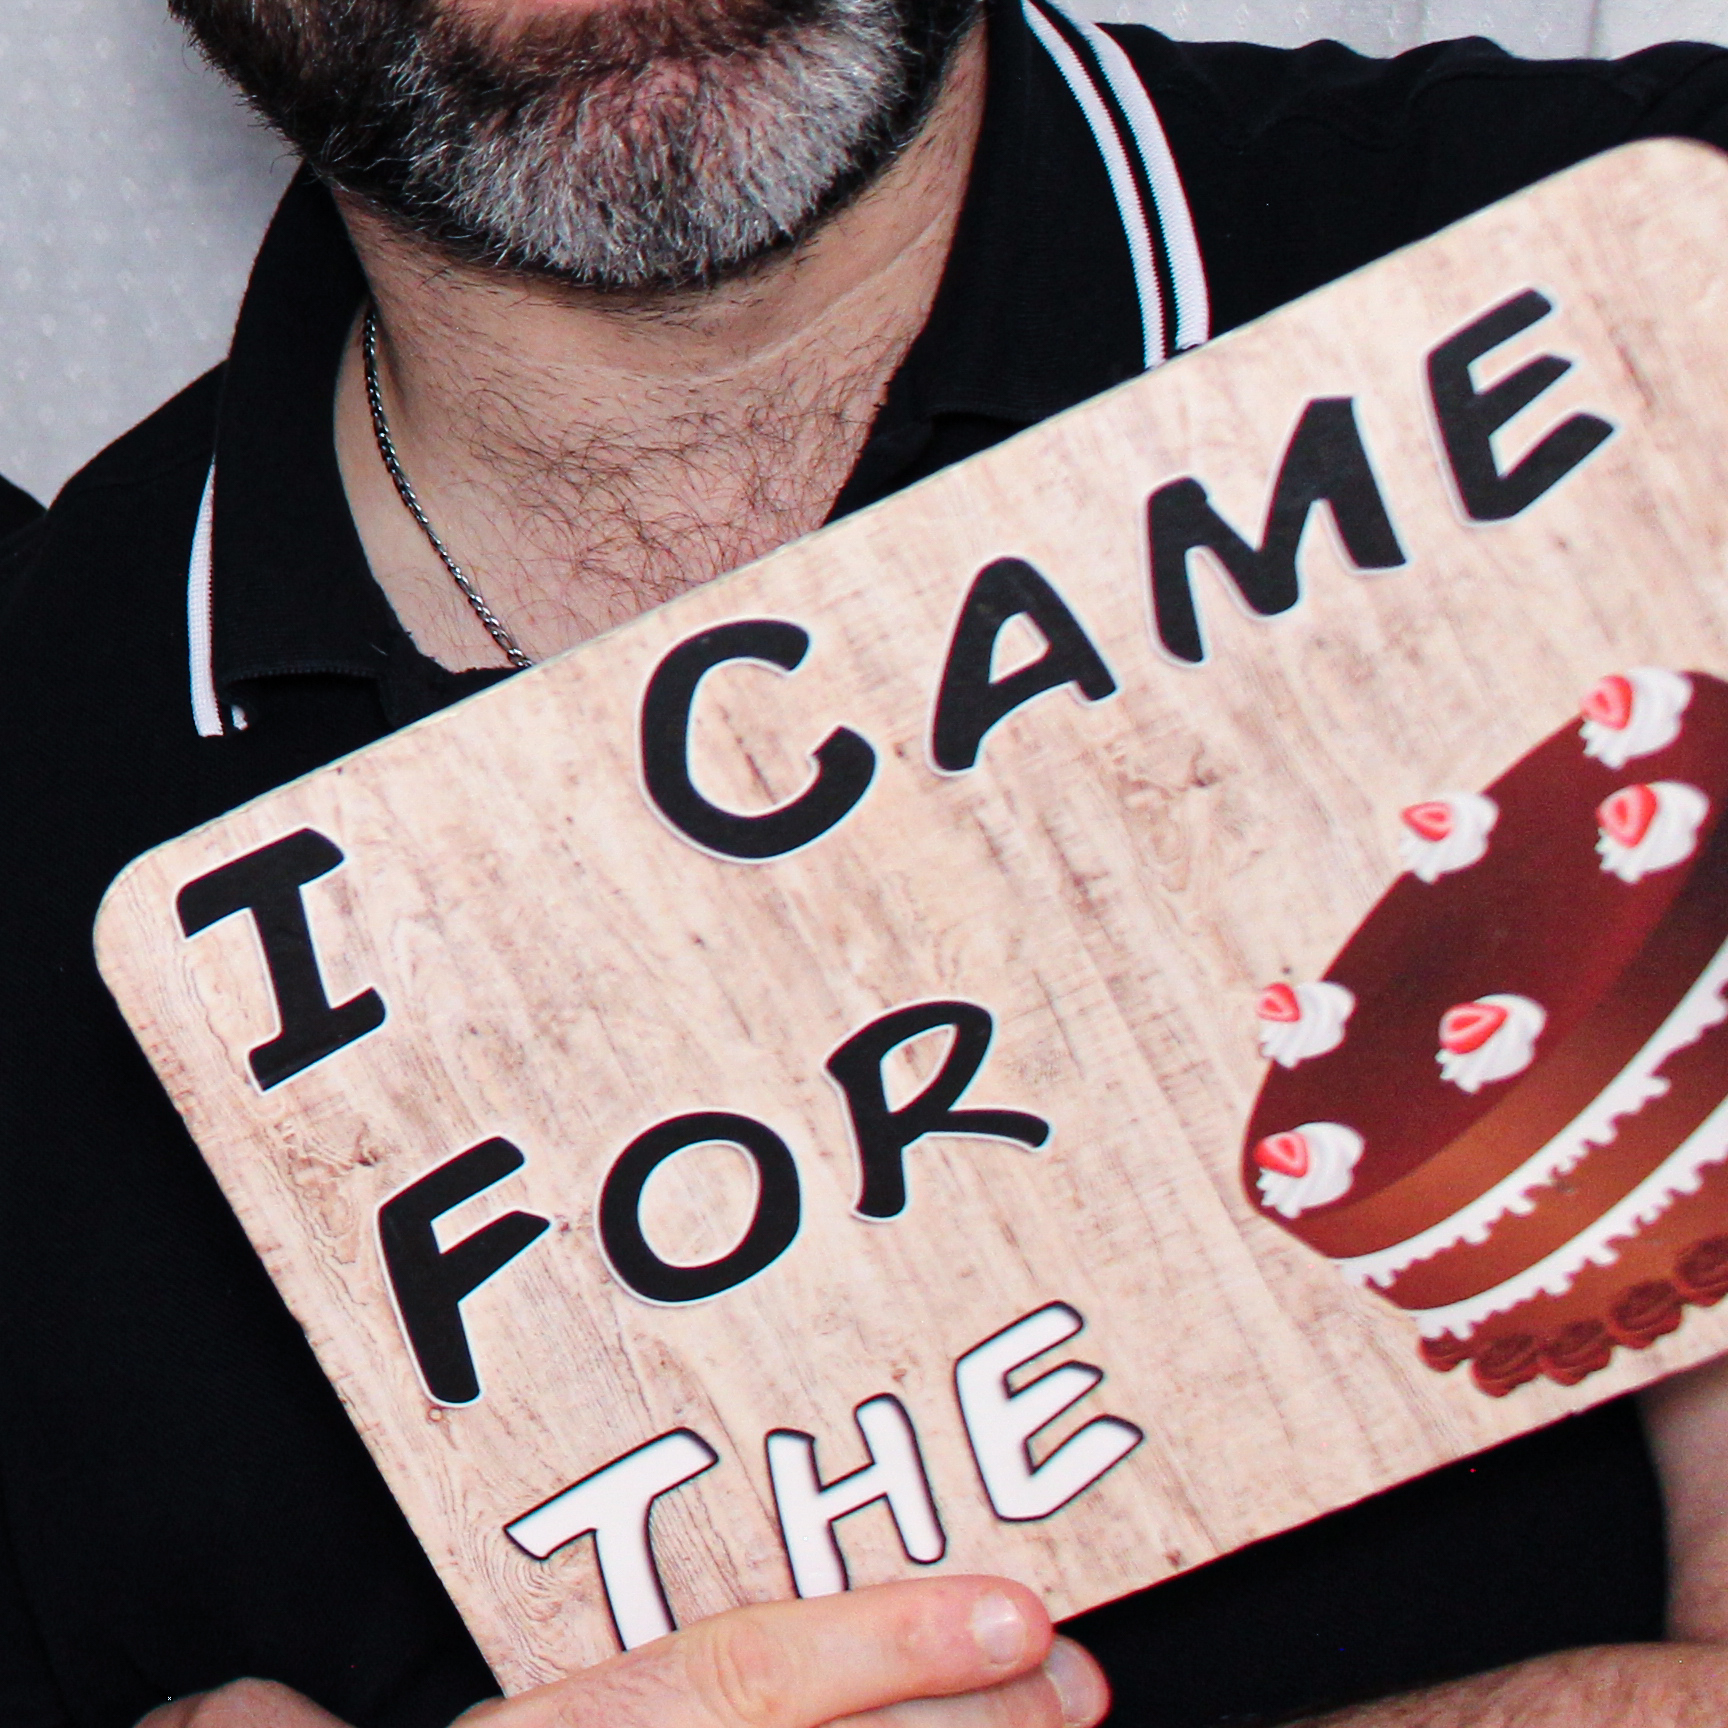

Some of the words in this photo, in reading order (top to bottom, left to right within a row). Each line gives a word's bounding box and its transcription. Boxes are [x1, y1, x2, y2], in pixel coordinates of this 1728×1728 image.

[178, 829, 386, 1092] I
[641, 288, 1616, 862] CAME
[375, 1000, 1050, 1406] FOR
[505, 1301, 1146, 1652] THE
